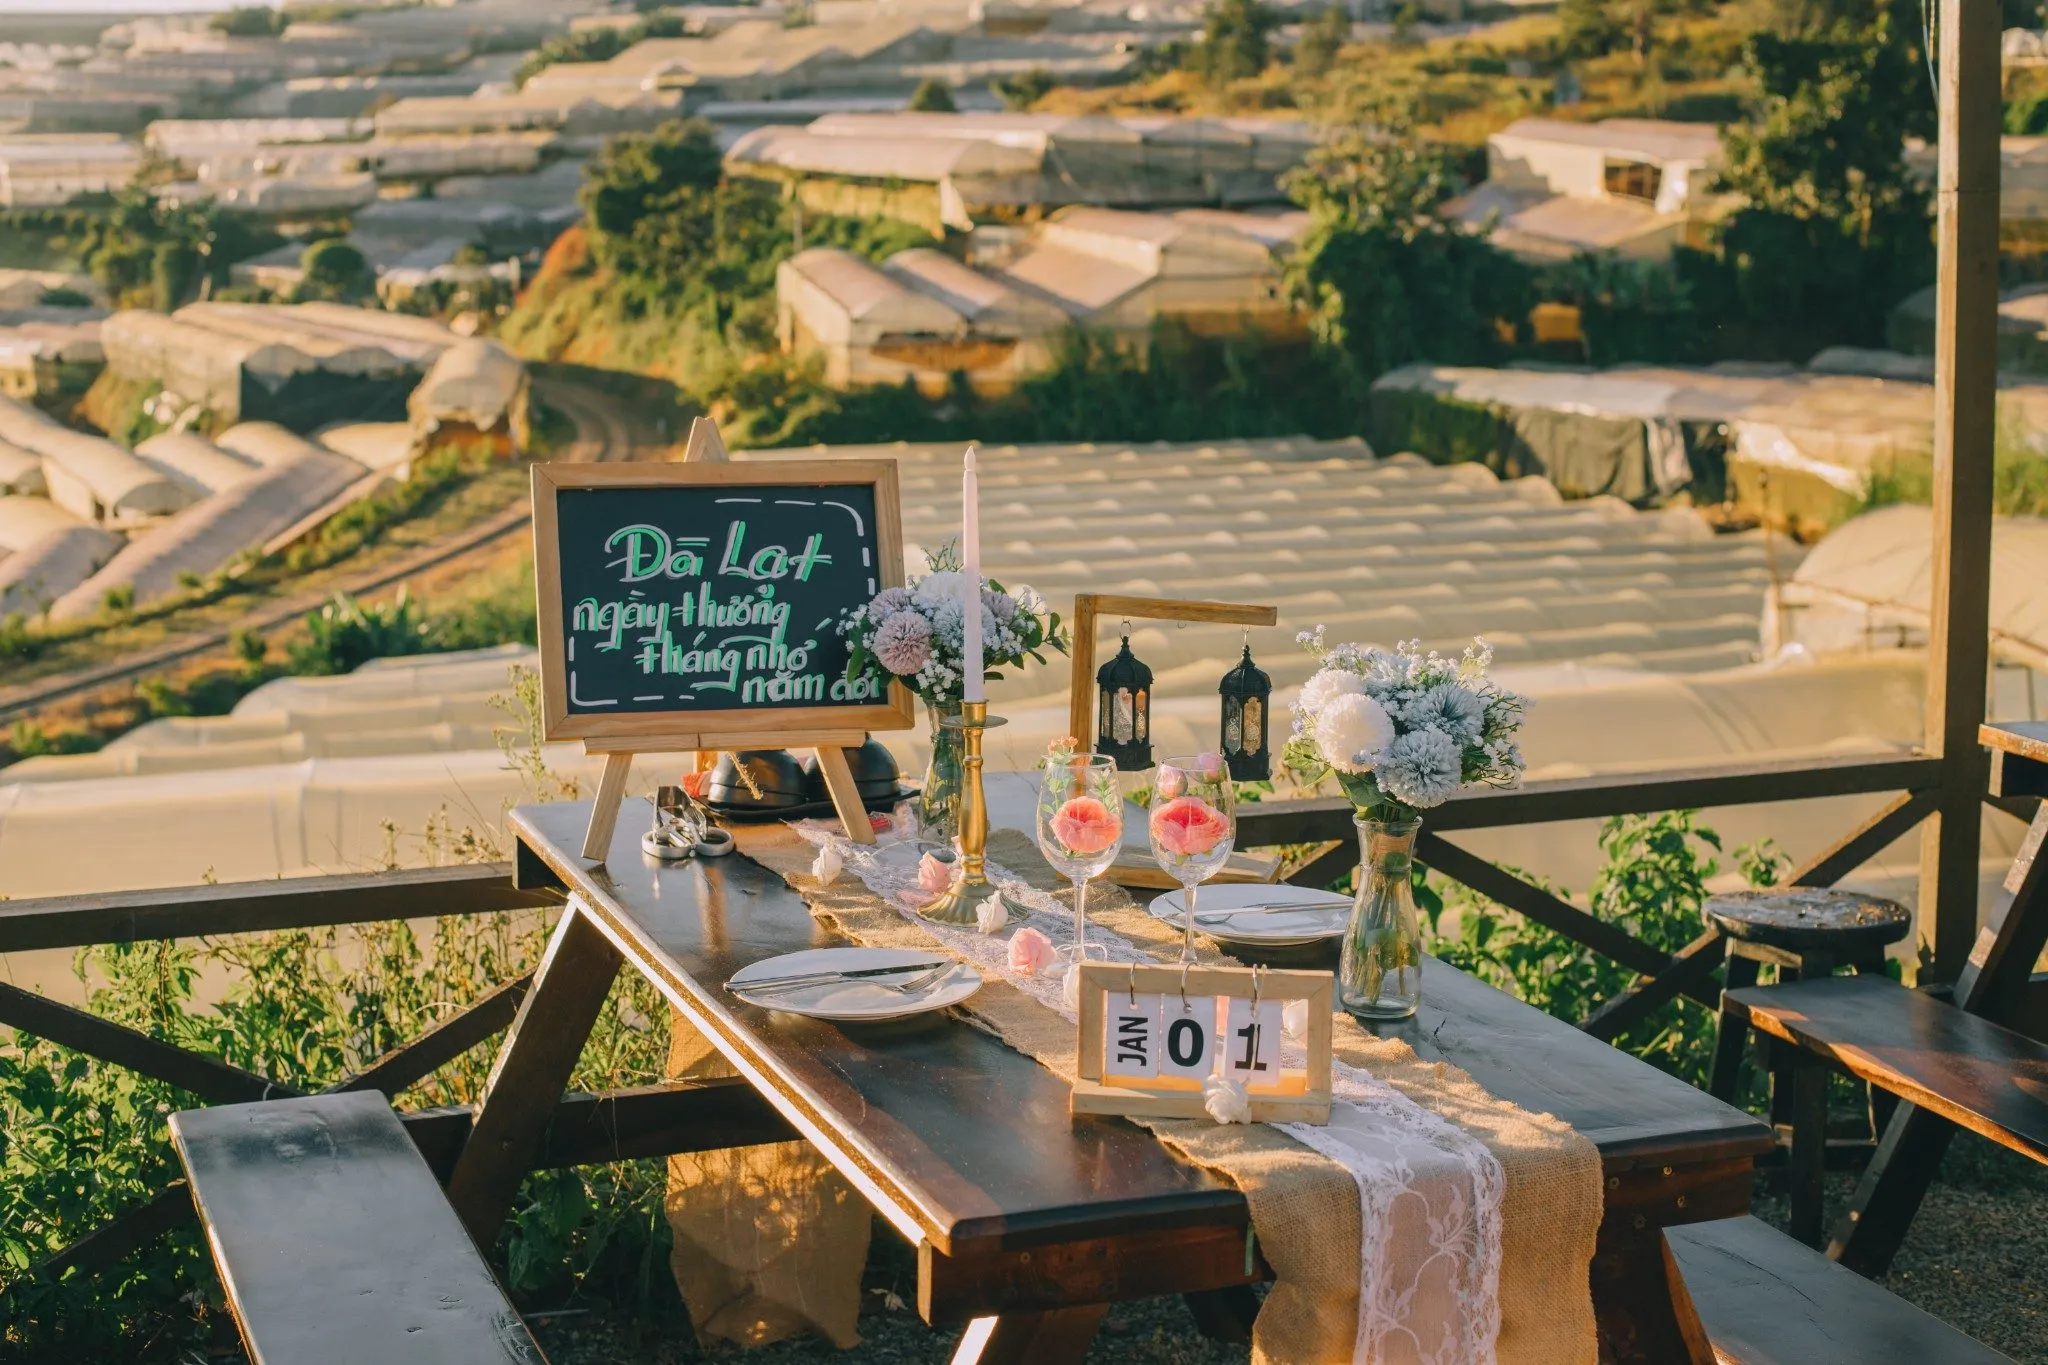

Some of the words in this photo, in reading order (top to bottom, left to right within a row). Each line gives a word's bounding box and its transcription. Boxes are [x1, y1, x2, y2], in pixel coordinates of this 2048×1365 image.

[572, 588, 671, 653] ngày
[634, 630, 743, 692] tháng
[742, 670, 826, 703] năm
[1117, 1016, 1148, 1067] JAN
